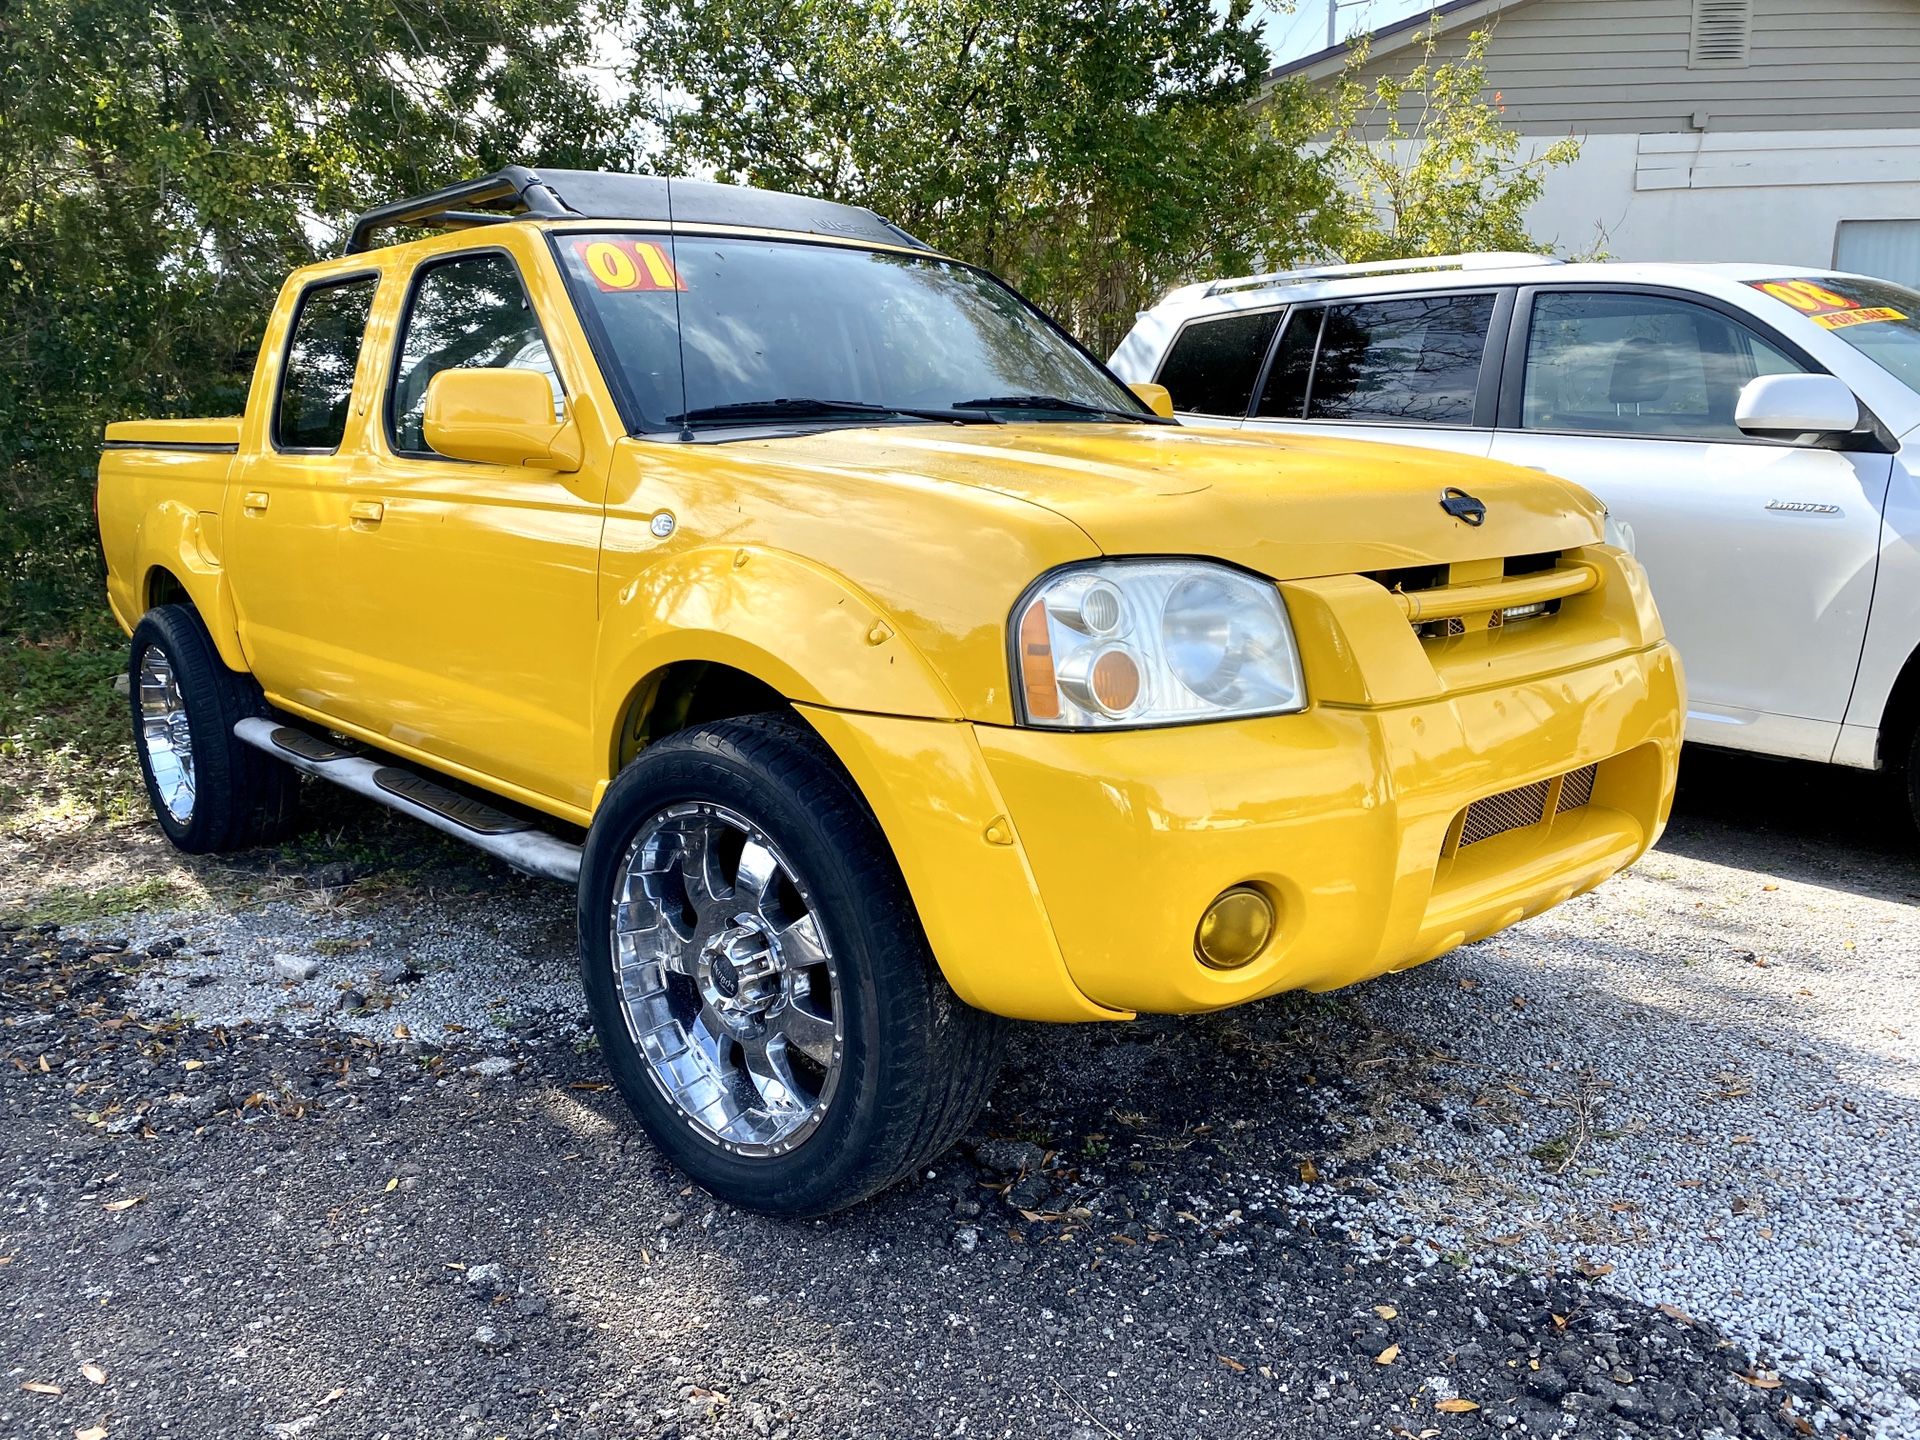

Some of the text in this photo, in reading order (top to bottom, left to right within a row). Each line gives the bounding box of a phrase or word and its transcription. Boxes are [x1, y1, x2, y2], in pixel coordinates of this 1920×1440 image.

[586, 242, 682, 289] 01
[1762, 281, 1850, 312] 08
[1823, 312, 1855, 326] FOR
